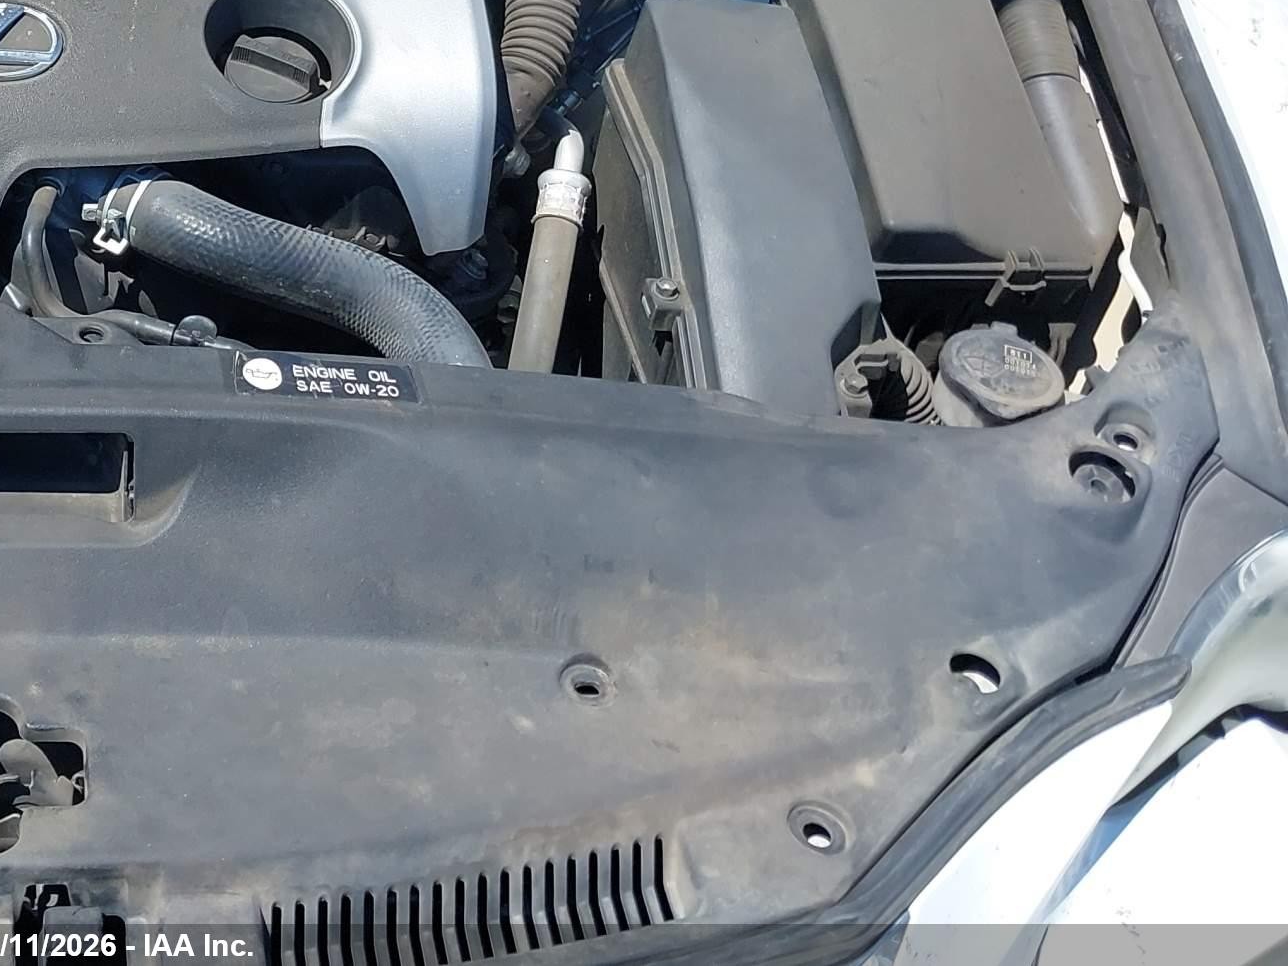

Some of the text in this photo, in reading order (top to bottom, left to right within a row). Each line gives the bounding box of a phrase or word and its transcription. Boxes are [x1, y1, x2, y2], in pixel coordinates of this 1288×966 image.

[292, 364, 397, 383] ENGINE OIL
[296, 380, 400, 398] SAE 0W-20
